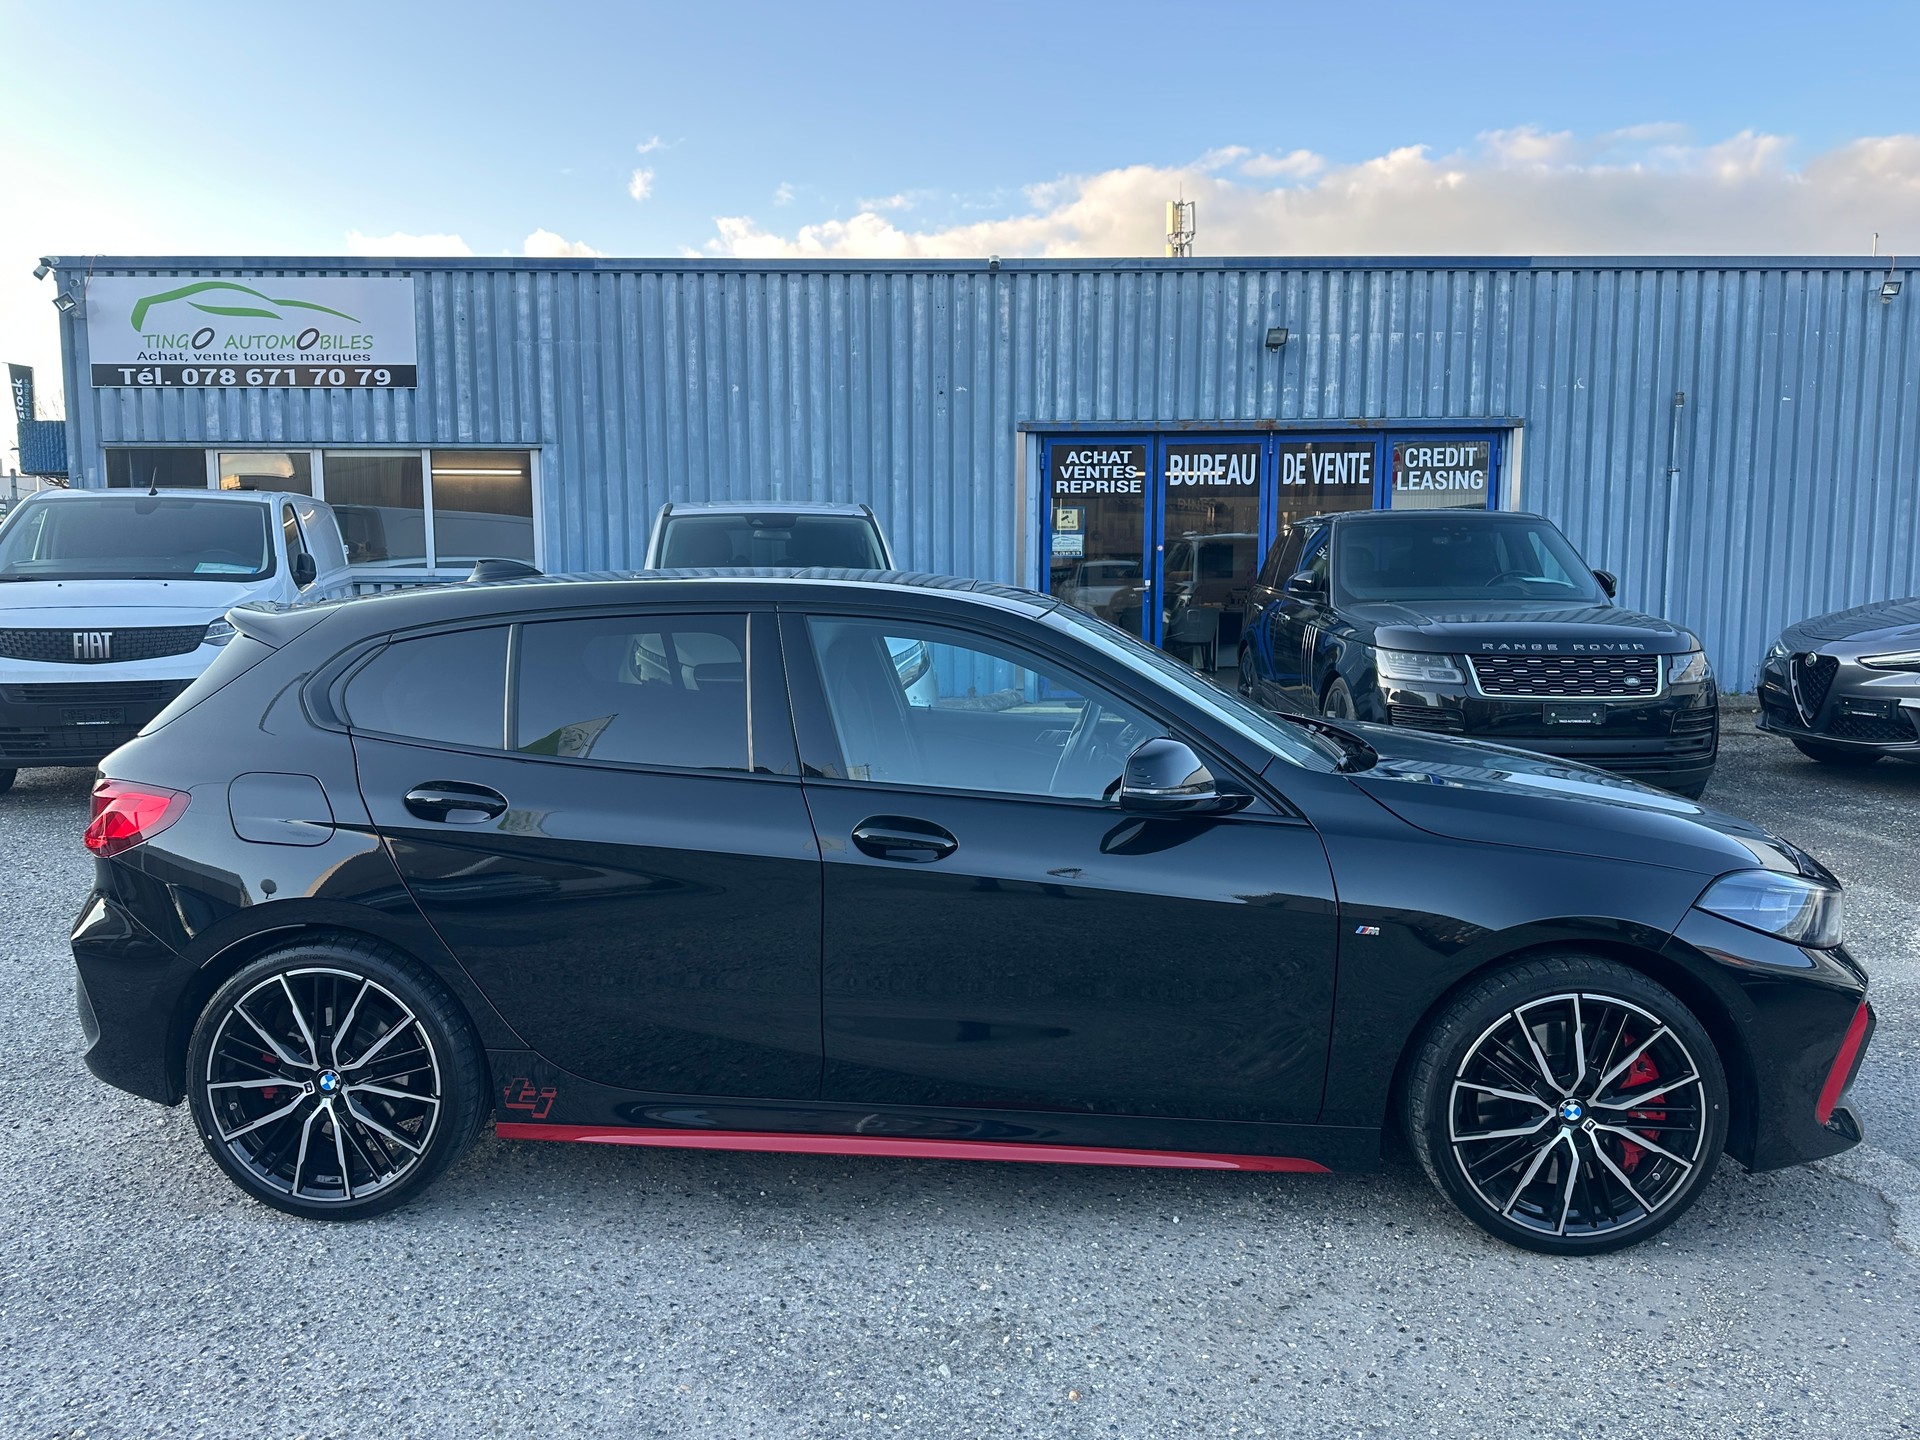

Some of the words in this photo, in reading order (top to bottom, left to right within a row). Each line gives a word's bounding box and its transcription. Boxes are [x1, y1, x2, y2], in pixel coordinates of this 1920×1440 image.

[142, 327, 216, 350] TINGO
[223, 327, 374, 351] AUTOMOBILES
[136, 351, 189, 363] Achat,
[193, 352, 238, 362] vente
[243, 351, 296, 362] toutes
[300, 352, 371, 364] marques
[117, 367, 171, 386] Tél.
[181, 368, 236, 386] 078
[245, 368, 297, 386] 671
[308, 368, 347, 386] 70
[354, 368, 392, 386] 79
[11, 378, 26, 422] stock
[1065, 450, 1133, 464] ACHAT
[1404, 447, 1478, 468] CREDIT
[1059, 465, 1138, 479] VENTES
[1169, 453, 1257, 487] BUREAU
[1282, 452, 1306, 485] DE
[1311, 451, 1371, 485] VENTE
[1055, 480, 1142, 494] REPRISE
[1396, 469, 1484, 491] LEASING
[72, 631, 113, 660] FIAT
[1481, 642, 1559, 651] RANGE
[1572, 642, 1645, 651] ROVER
